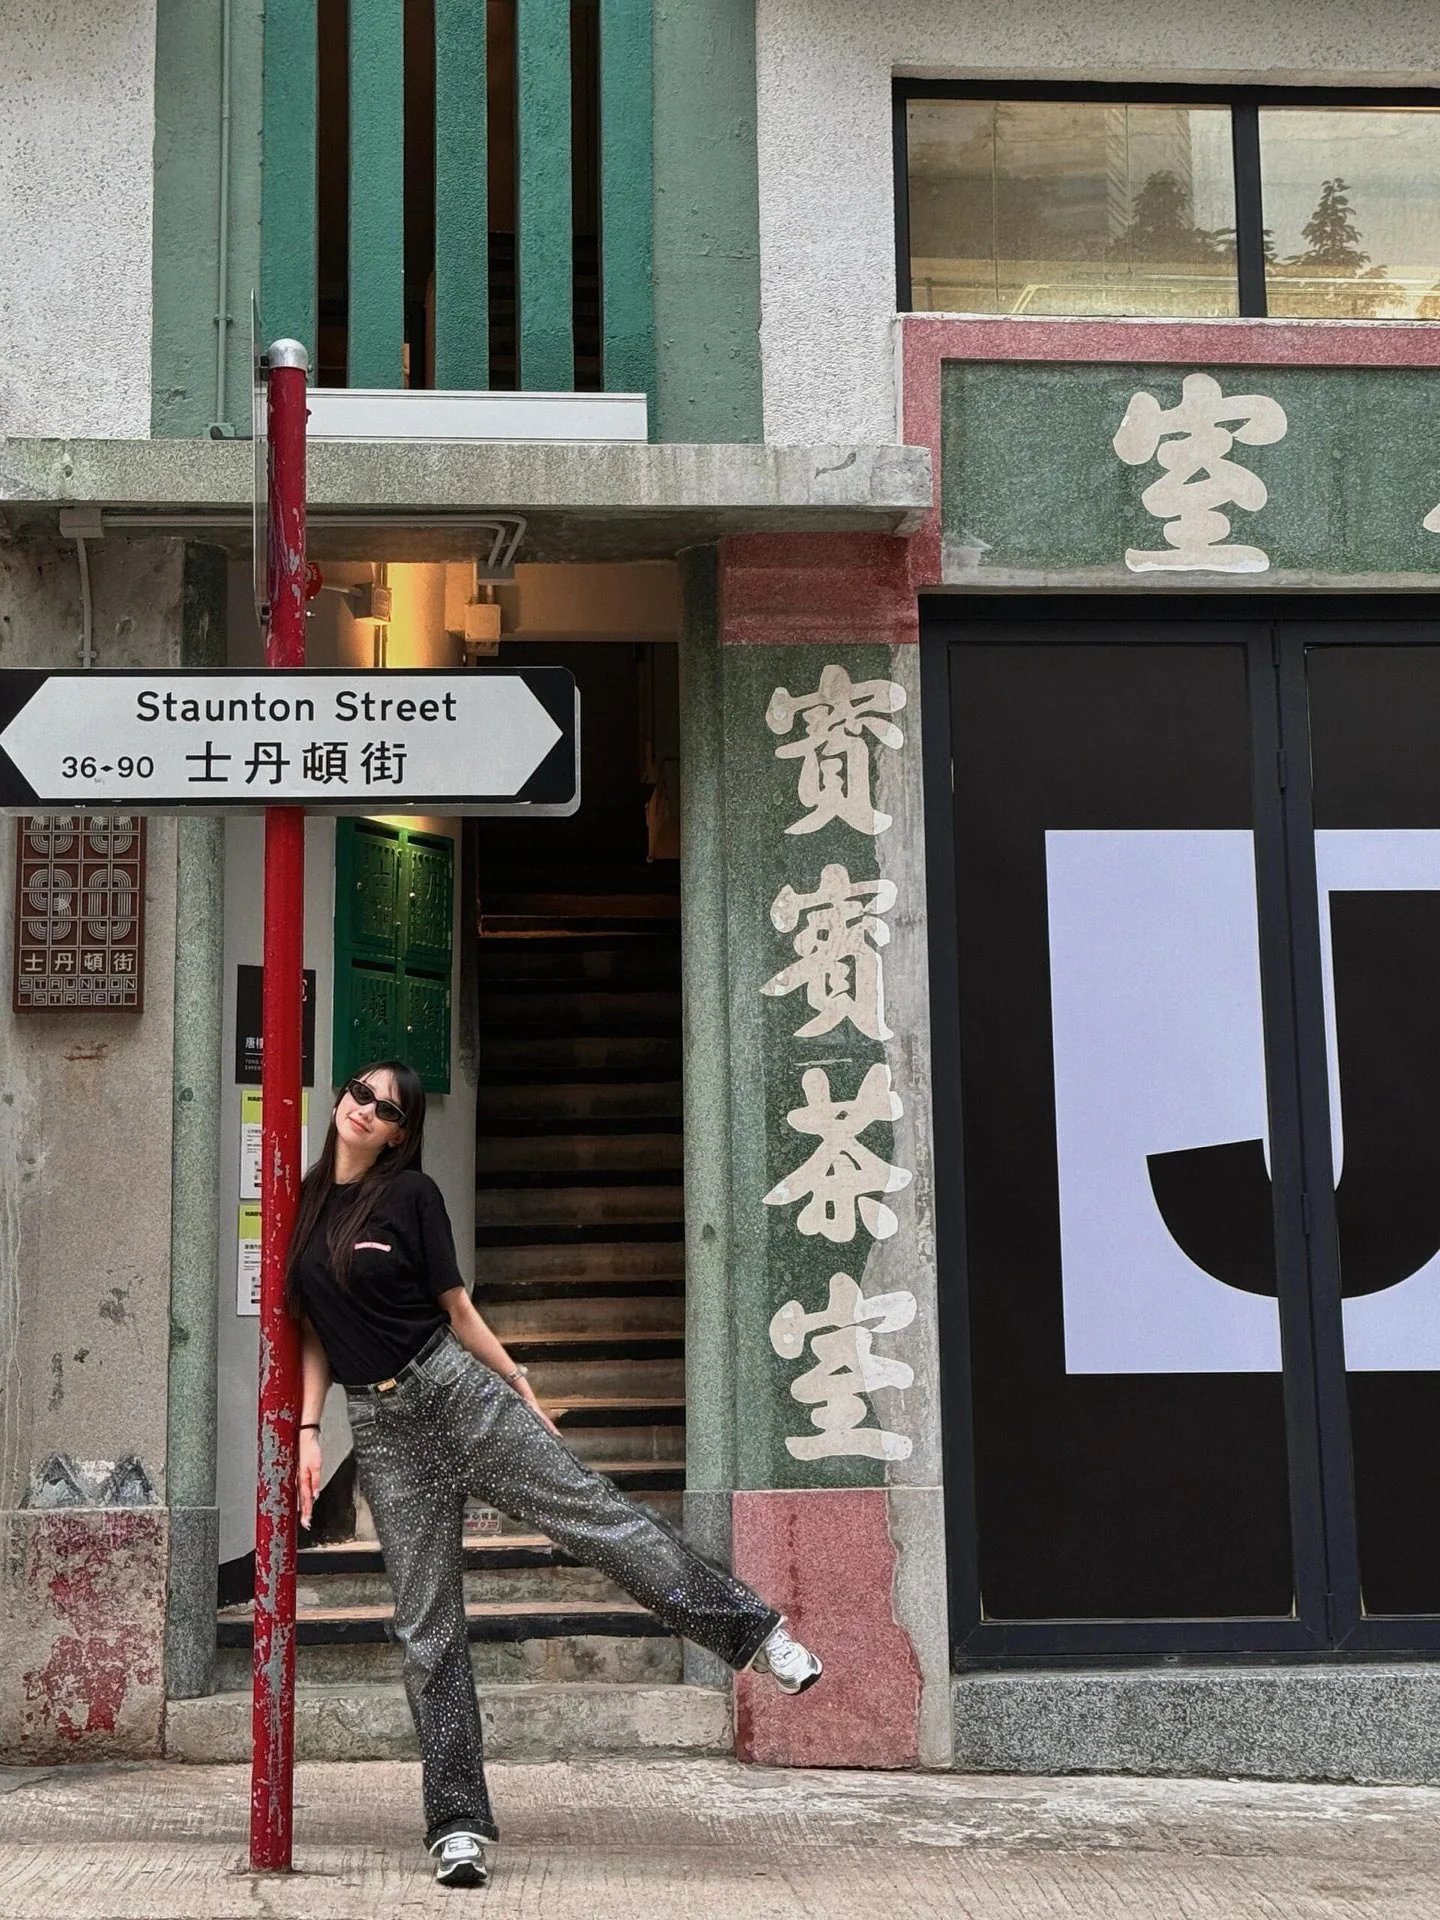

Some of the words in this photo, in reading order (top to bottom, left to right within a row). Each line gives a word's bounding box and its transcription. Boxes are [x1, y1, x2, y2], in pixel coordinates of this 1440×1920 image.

[136, 690, 315, 722] Staunton
[334, 690, 457, 722] Street
[185, 740, 408, 786] 士丹頓街
[23, 952, 134, 973] 士丹頓街
[20, 979, 135, 989] STAUNTON
[35, 993, 119, 1003] STREET
